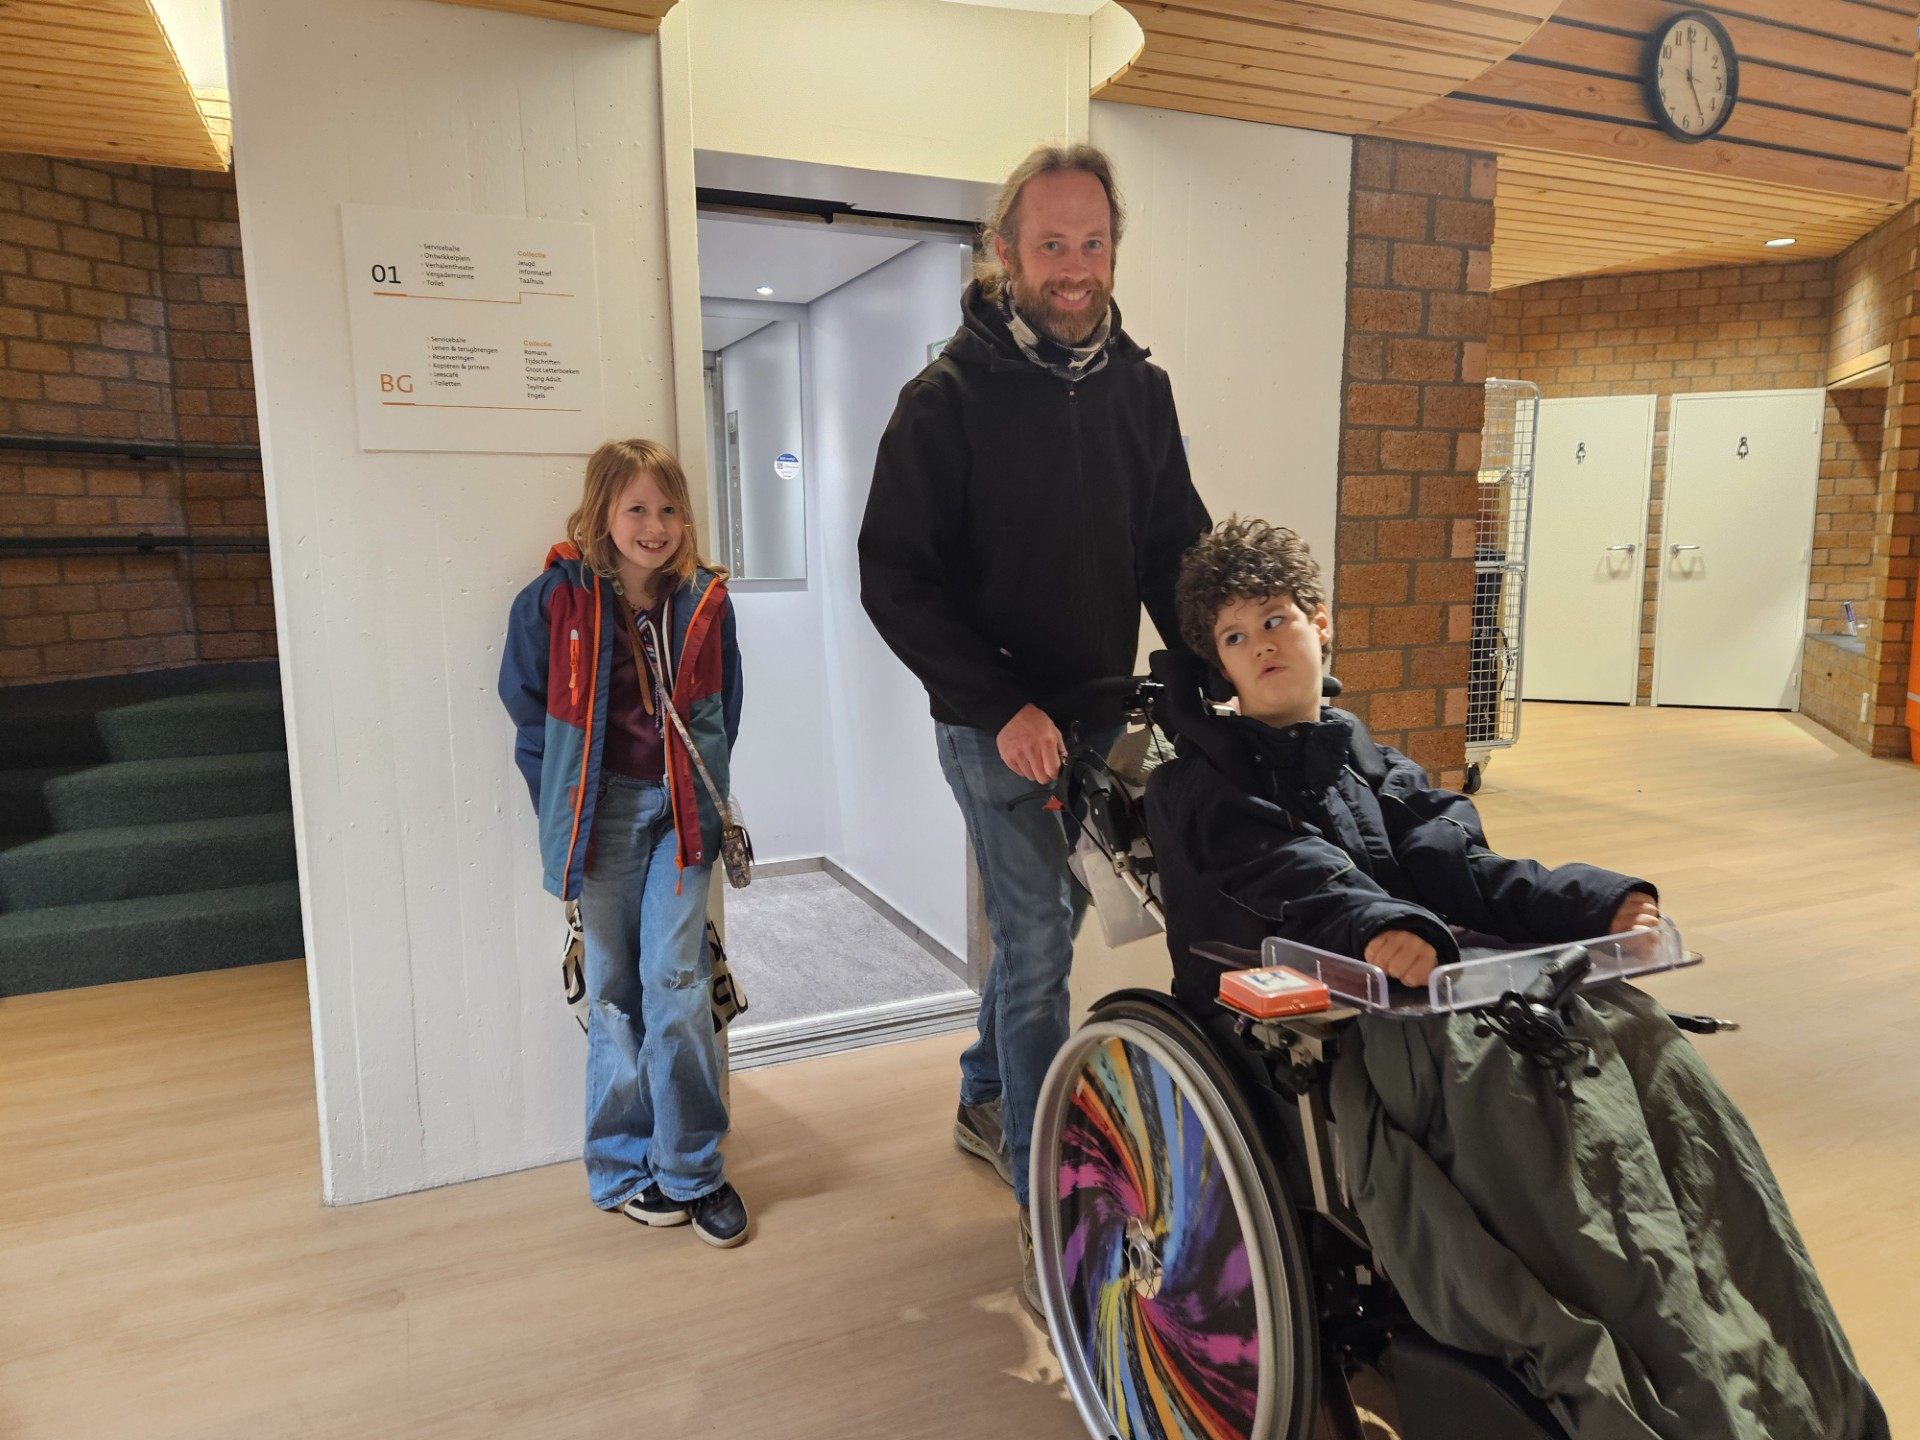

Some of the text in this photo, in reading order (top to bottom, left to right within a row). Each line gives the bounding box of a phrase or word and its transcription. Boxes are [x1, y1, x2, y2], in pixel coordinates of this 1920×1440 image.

[1676, 31, 1682, 46] 11
[1687, 26, 1696, 43] 12
[1662, 45, 1672, 59] 10
[1712, 56, 1718, 69] 2
[1658, 65, 1663, 79] 9
[1716, 77, 1722, 91] 3
[1661, 88, 1665, 102] 8
[1708, 97, 1715, 111] 4
[1670, 107, 1675, 121] 7
[1697, 112, 1704, 127] 5
[1683, 115, 1689, 129] 6
[424, 253, 470, 262] Ontwikkelplein
[371, 264, 401, 284] 01
[426, 271, 474, 279] Vergaderruimte
[380, 373, 413, 393] BG
